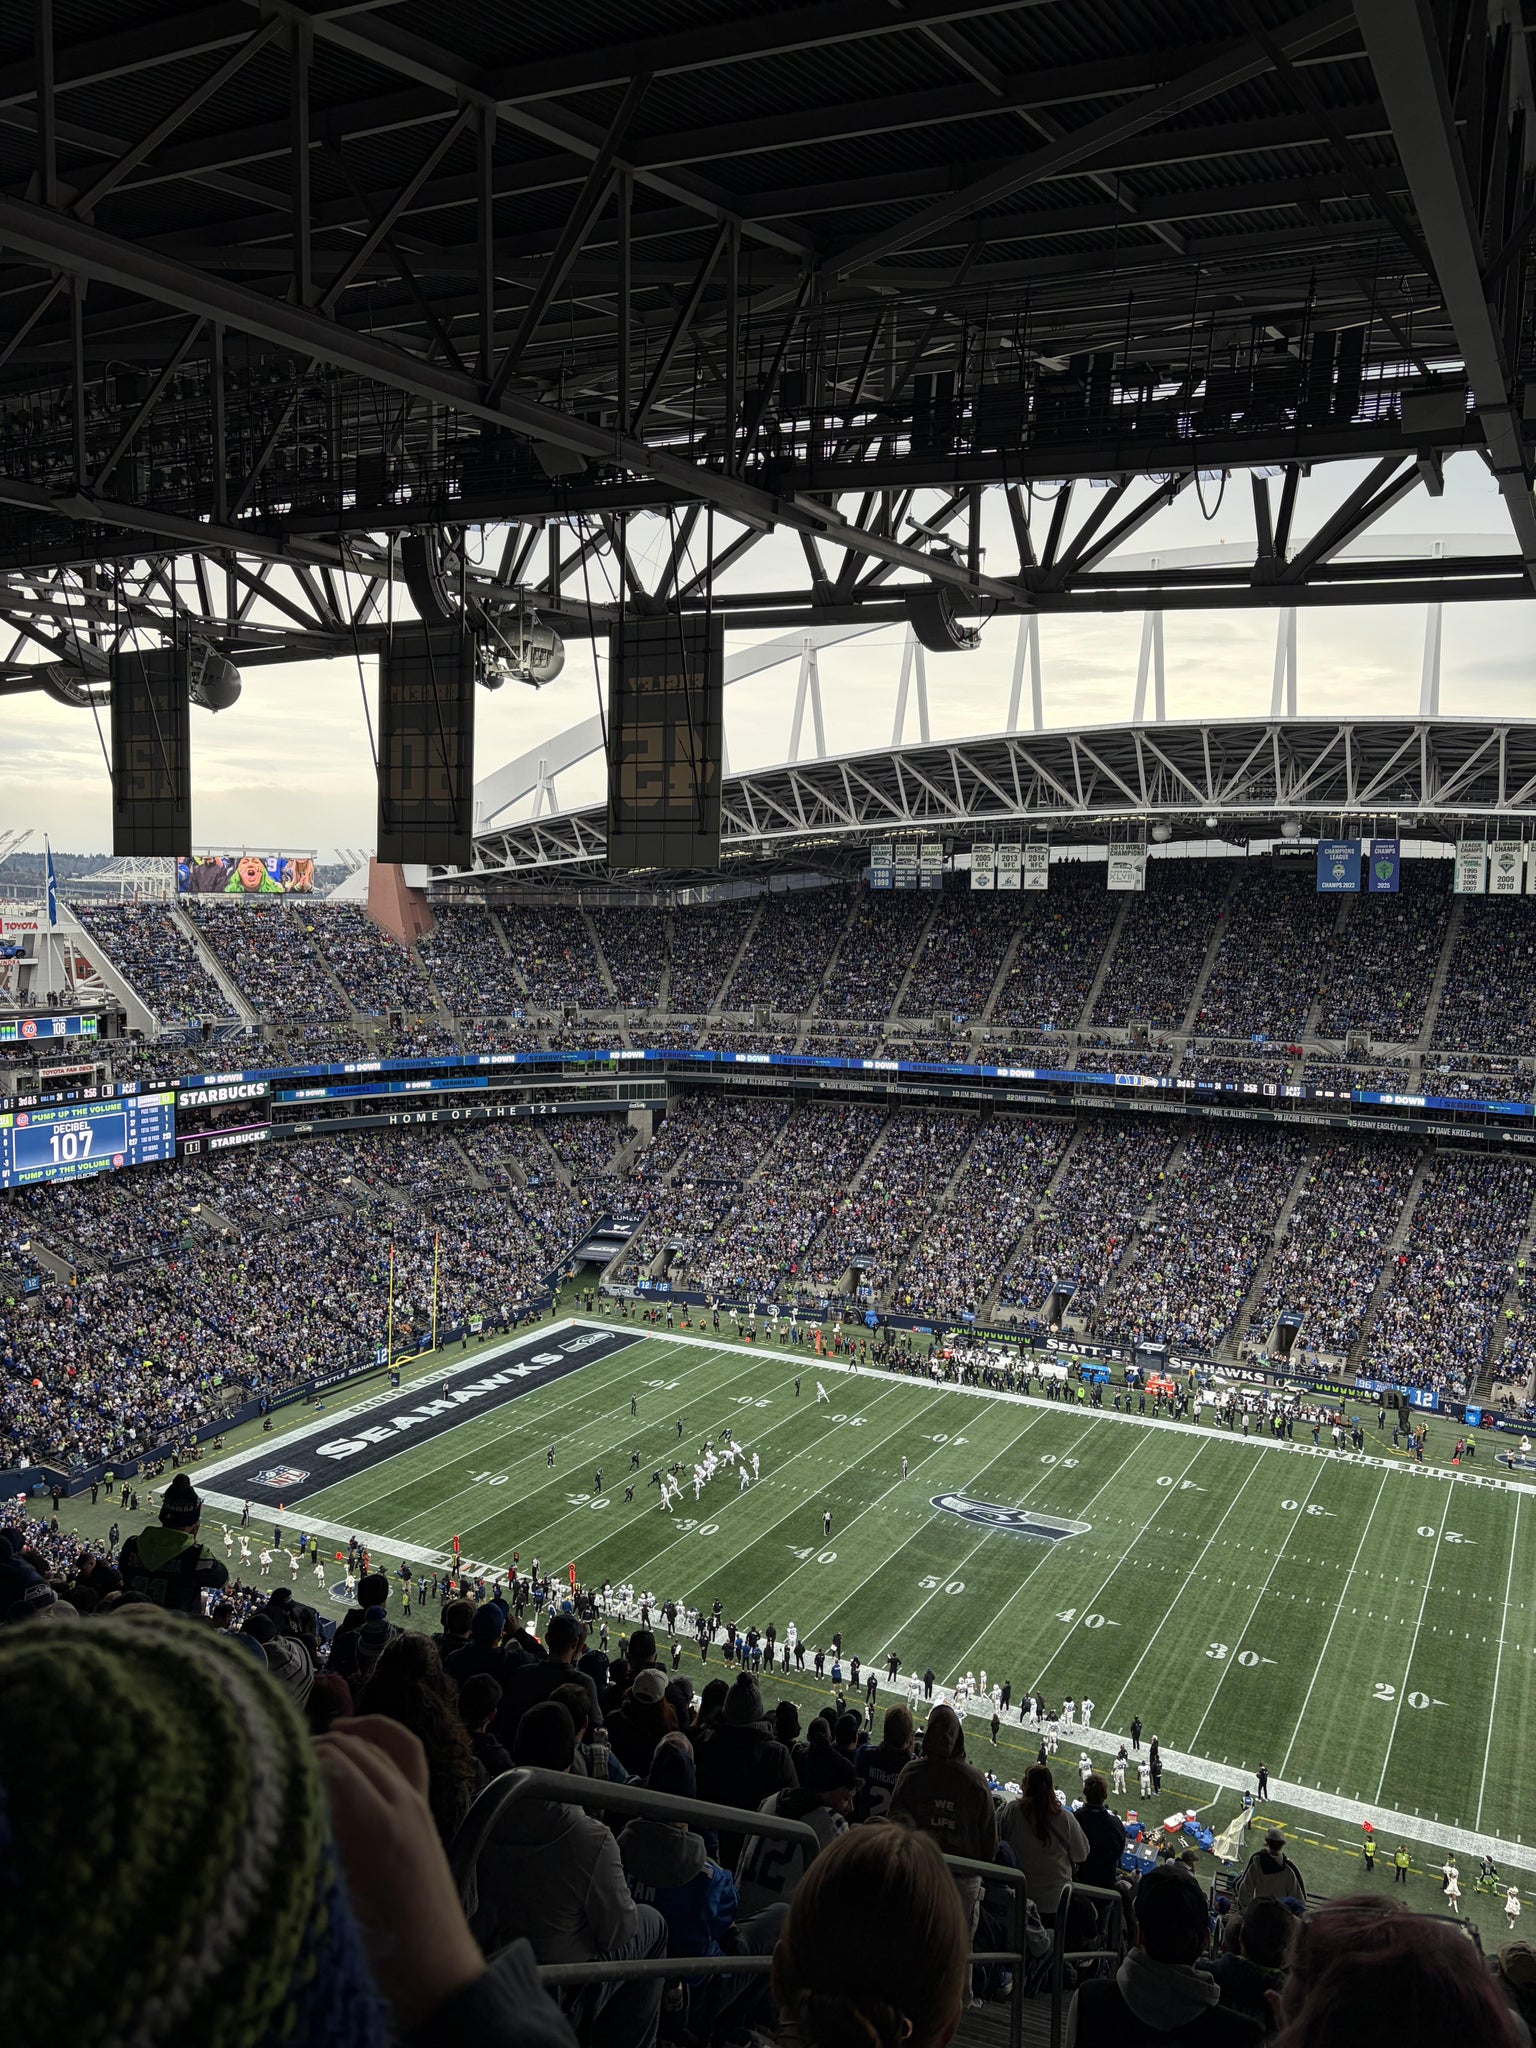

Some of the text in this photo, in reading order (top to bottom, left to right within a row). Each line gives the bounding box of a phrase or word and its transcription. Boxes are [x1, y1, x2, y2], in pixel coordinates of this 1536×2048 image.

[5, 922, 38, 930] TOYOTA
[52, 1022, 66, 1035] 108
[492, 1055, 515, 1063] DOWN
[747, 1055, 770, 1063] DOWN
[357, 1063, 381, 1072] DOWN
[875, 1062, 898, 1070] DOWN
[218, 1073, 243, 1083] DOWN
[1009, 1070, 1035, 1078] DOWN
[412, 1081, 431, 1089] DOWN
[749, 1078, 776, 1086] ALEXANDER
[1162, 1078, 1167, 1087] 0
[180, 1084, 264, 1107] STARBUCKS
[305, 1089, 326, 1097] DOWN
[908, 1088, 929, 1096] LARGENT
[4, 1099, 9, 1109] 0
[1027, 1095, 1046, 1103] BROWN
[1087, 1100, 1104, 1108] GROSS
[1395, 1096, 1425, 1106] DOWN
[32, 1113, 56, 1122] PUMP
[72, 1108, 88, 1116] THE
[90, 1103, 122, 1114] VOLUME
[390, 1106, 557, 1124] HOME OF THE 12s
[1152, 1105, 1175, 1113] WARNER
[1301, 1116, 1318, 1125] GREEN
[1358, 1121, 1376, 1129] KENNY
[1377, 1122, 1397, 1131] EASLEY
[53, 1121, 91, 1135] DECIBEL
[1436, 1127, 1451, 1136] DAVE
[1452, 1129, 1471, 1137] KRIEG
[211, 1133, 266, 1148] STARBUCKS
[1514, 1134, 1535, 1143] CHUCK
[50, 1130, 94, 1163] 107
[19, 1160, 110, 1181] PUMP UP THE VOLUME
[78, 1171, 99, 1180] ELECTRIC
[28, 1279, 37, 1287] 12
[659, 1283, 668, 1291] 12
[376, 1350, 388, 1364] 12
[1168, 1357, 1266, 1383] SEAHAWKS
[314, 1372, 346, 1389] SEATTLE
[648, 1379, 680, 1390] 10
[1359, 1380, 1372, 1389] 96
[351, 1368, 458, 1414] CHOOSE LOVE
[738, 1397, 774, 1407] 20
[1415, 1390, 1433, 1408] 12
[316, 1353, 565, 1460] SEAHAWKS
[831, 1414, 868, 1427] 30
[932, 1433, 970, 1446] 40
[1040, 1454, 1080, 1468] 50
[1282, 1442, 1508, 1489] INSPIRE CHANGE
[270, 1470, 304, 1488] NFL
[471, 1472, 509, 1486] 10
[1156, 1476, 1195, 1492] 40
[567, 1494, 611, 1510] 20
[1281, 1499, 1326, 1517] 30
[676, 1518, 720, 1536] 30
[1416, 1526, 1464, 1544] 20
[794, 1546, 838, 1564] 40
[917, 1575, 965, 1595] 50
[1055, 1608, 1105, 1629] 40
[1204, 1642, 1261, 1667] 30
[1372, 1682, 1432, 1710] 20
[869, 1785, 892, 1817] 2
[934, 1799, 956, 1812] WE
[930, 1816, 957, 1830] LIFE
